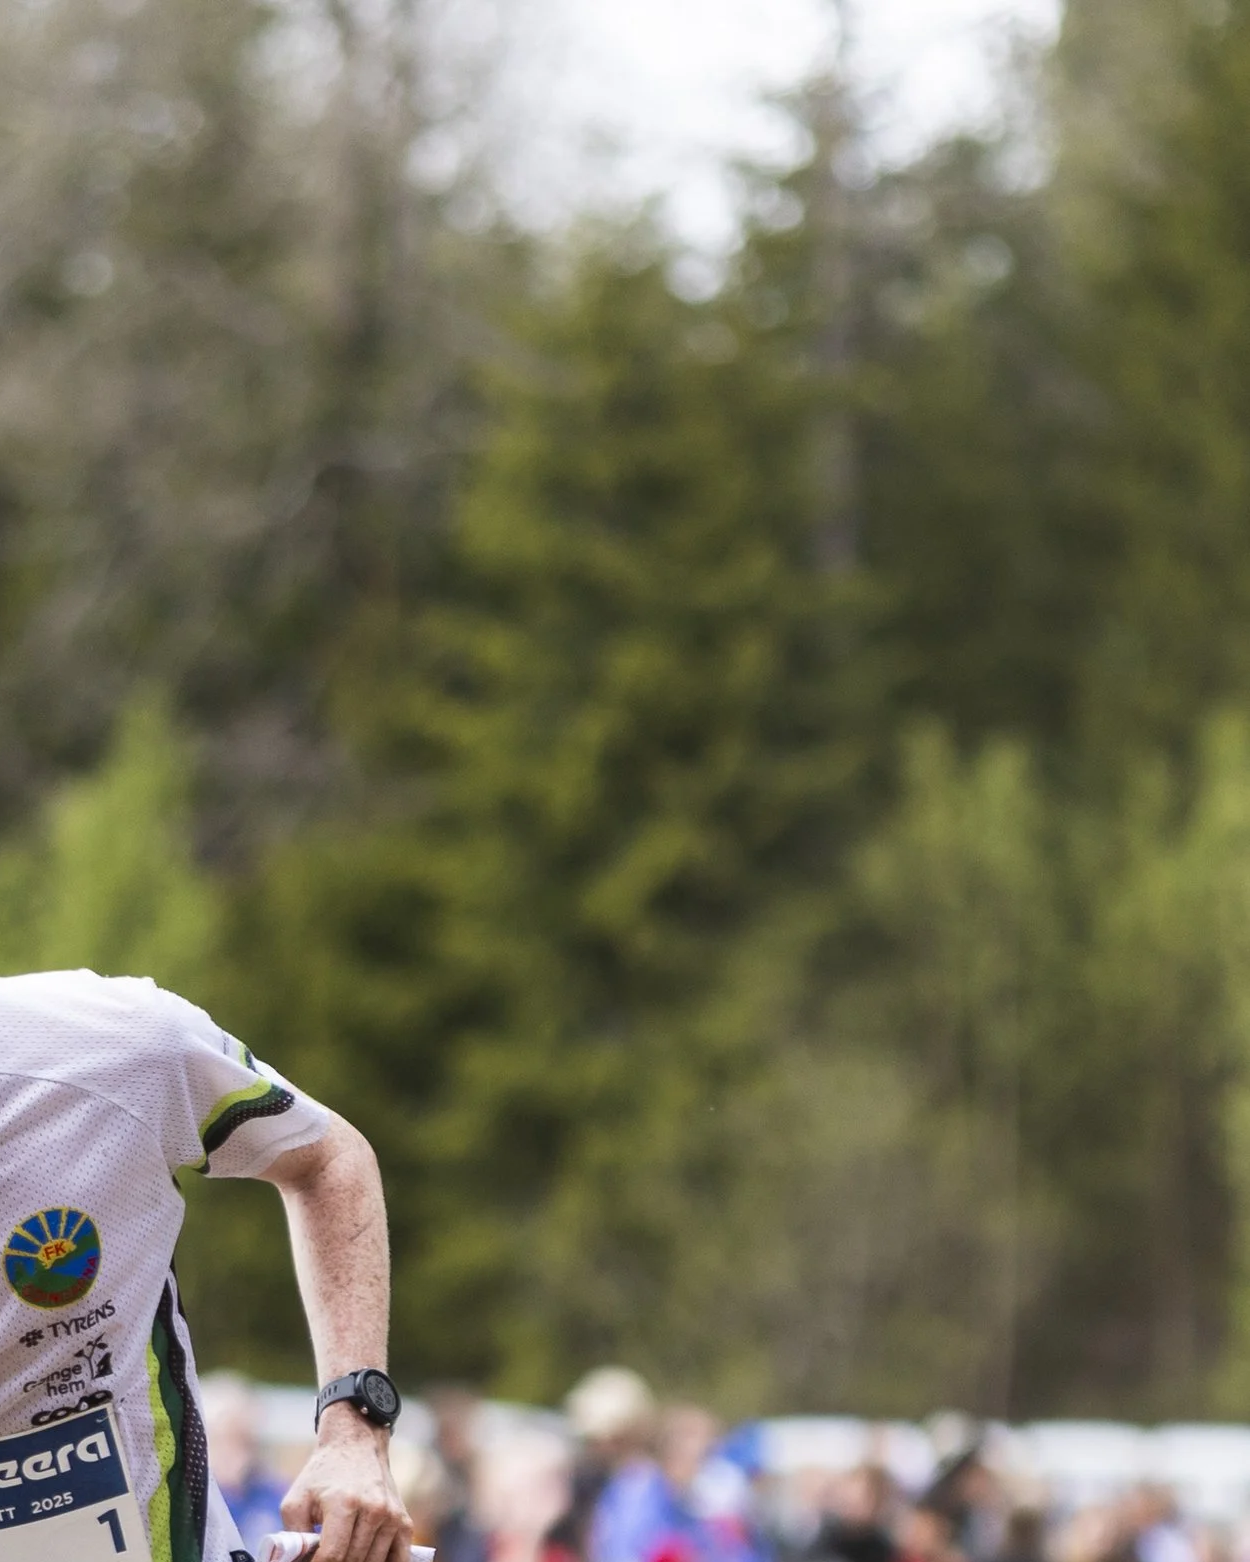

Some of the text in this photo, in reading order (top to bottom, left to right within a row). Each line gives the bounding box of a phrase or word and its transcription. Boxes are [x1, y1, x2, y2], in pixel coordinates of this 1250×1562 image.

[43, 1241, 67, 1260] FK
[46, 1380, 85, 1397] hem
[31, 1491, 74, 1515] 2025
[97, 1508, 127, 1554] 1
